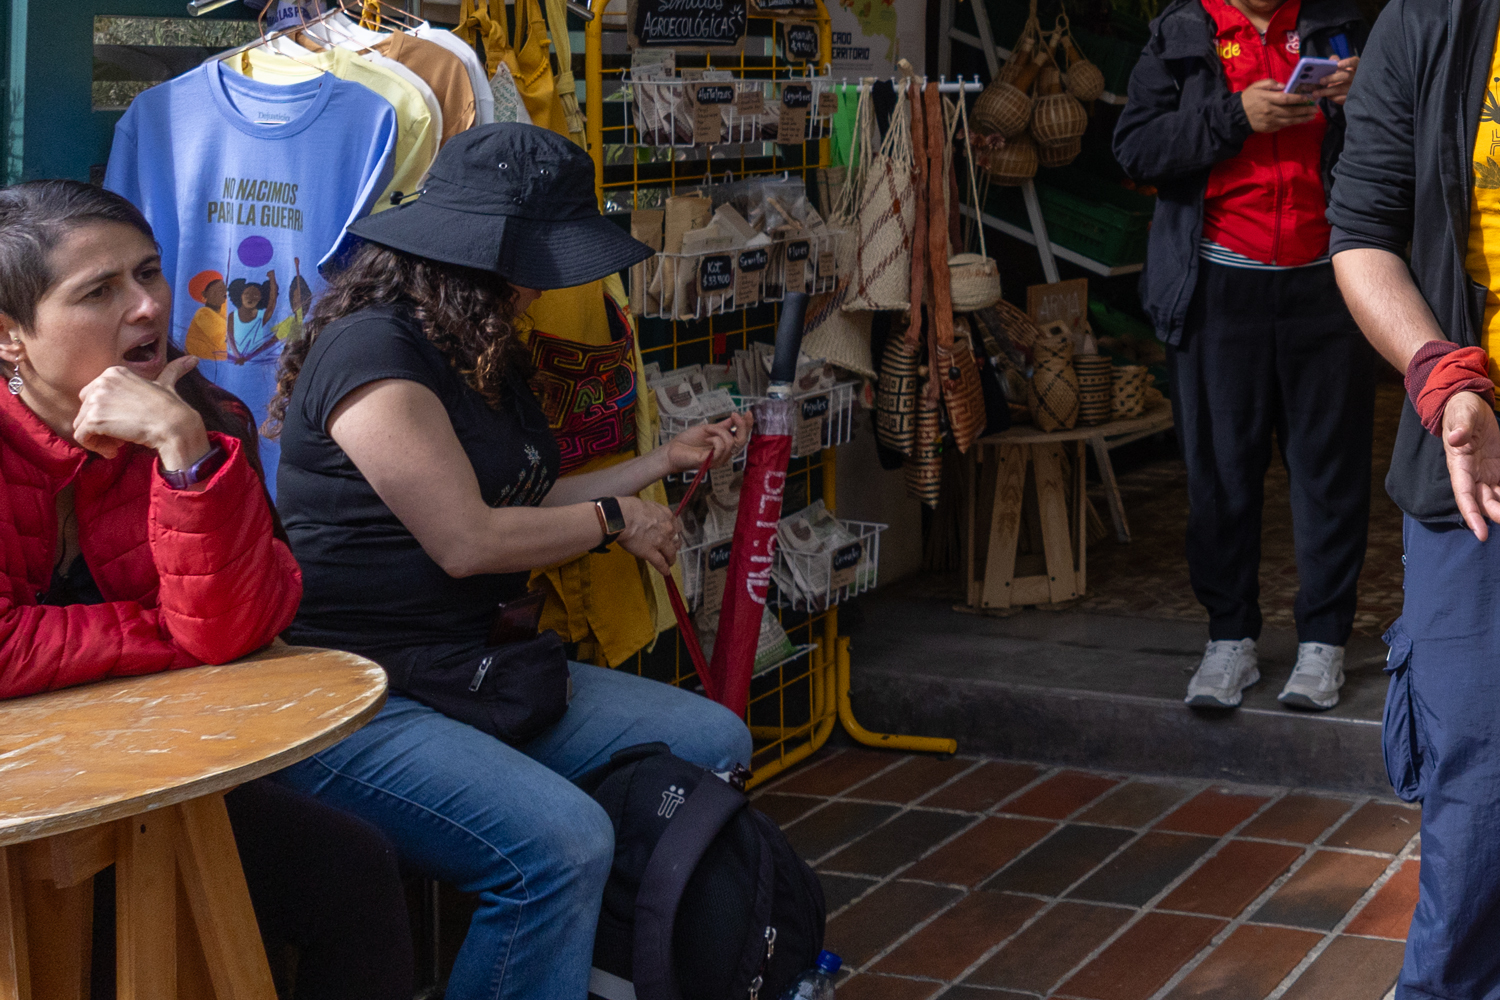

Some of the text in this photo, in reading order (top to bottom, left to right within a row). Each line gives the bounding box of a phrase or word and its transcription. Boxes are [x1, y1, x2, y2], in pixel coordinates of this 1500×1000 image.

[832, 32, 852, 45] CADO
[832, 47, 870, 60] ERRITORIO
[223, 178, 298, 205] NO NACIMOS
[237, 203, 256, 226] LA
